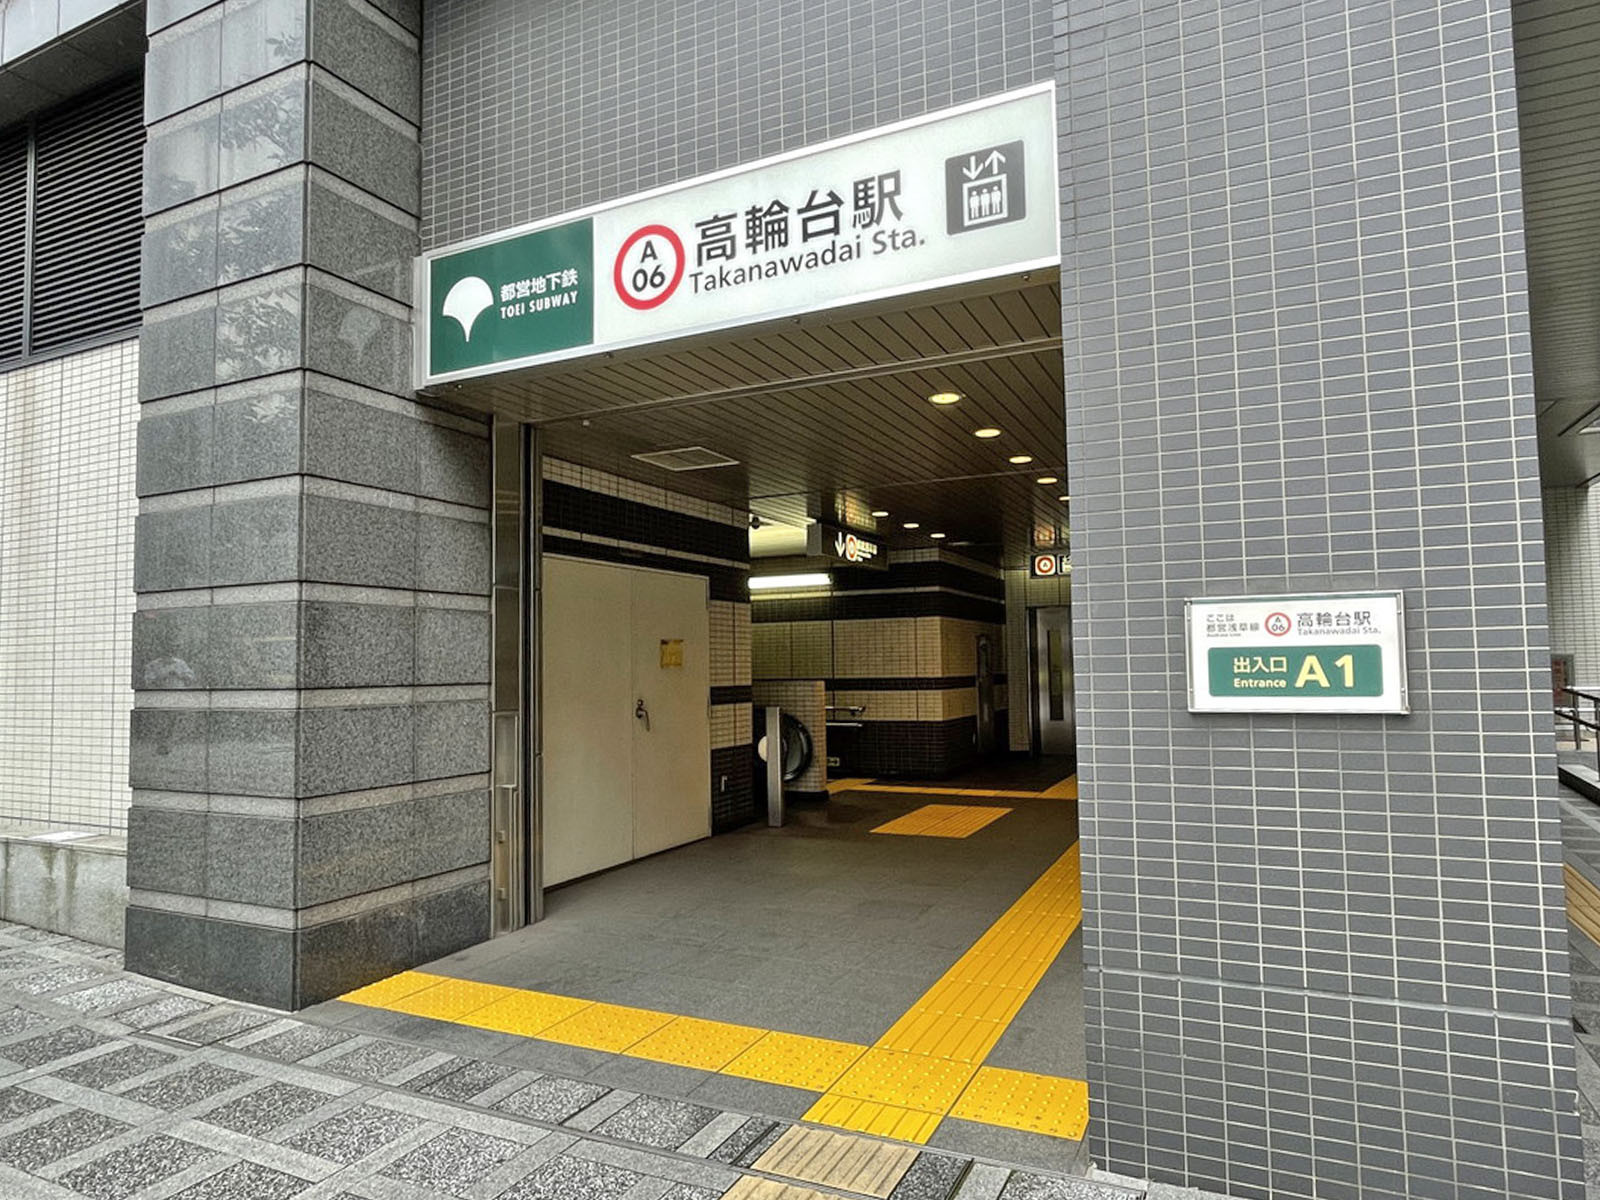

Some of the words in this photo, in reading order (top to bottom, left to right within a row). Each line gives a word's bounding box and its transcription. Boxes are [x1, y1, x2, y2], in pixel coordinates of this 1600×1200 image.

[695, 170, 904, 267] 高輪台駅
[640, 240, 658, 264] A
[689, 235, 862, 294] Takanawadai
[872, 228, 926, 256] Sta.
[500, 267, 578, 302] 都営地下鉄
[632, 264, 666, 292] 06
[500, 302, 525, 319] TOEI
[529, 290, 578, 313] SUBWAY
[1206, 614, 1234, 623] ここは
[1271, 623, 1285, 632] 06
[1296, 610, 1371, 627] 高輪台駅
[1297, 626, 1360, 636] Takanawadai
[1362, 626, 1381, 635] Sta.
[1233, 656, 1287, 674] 出入口
[1294, 654, 1354, 688] A1
[1233, 677, 1287, 688] Entrance
